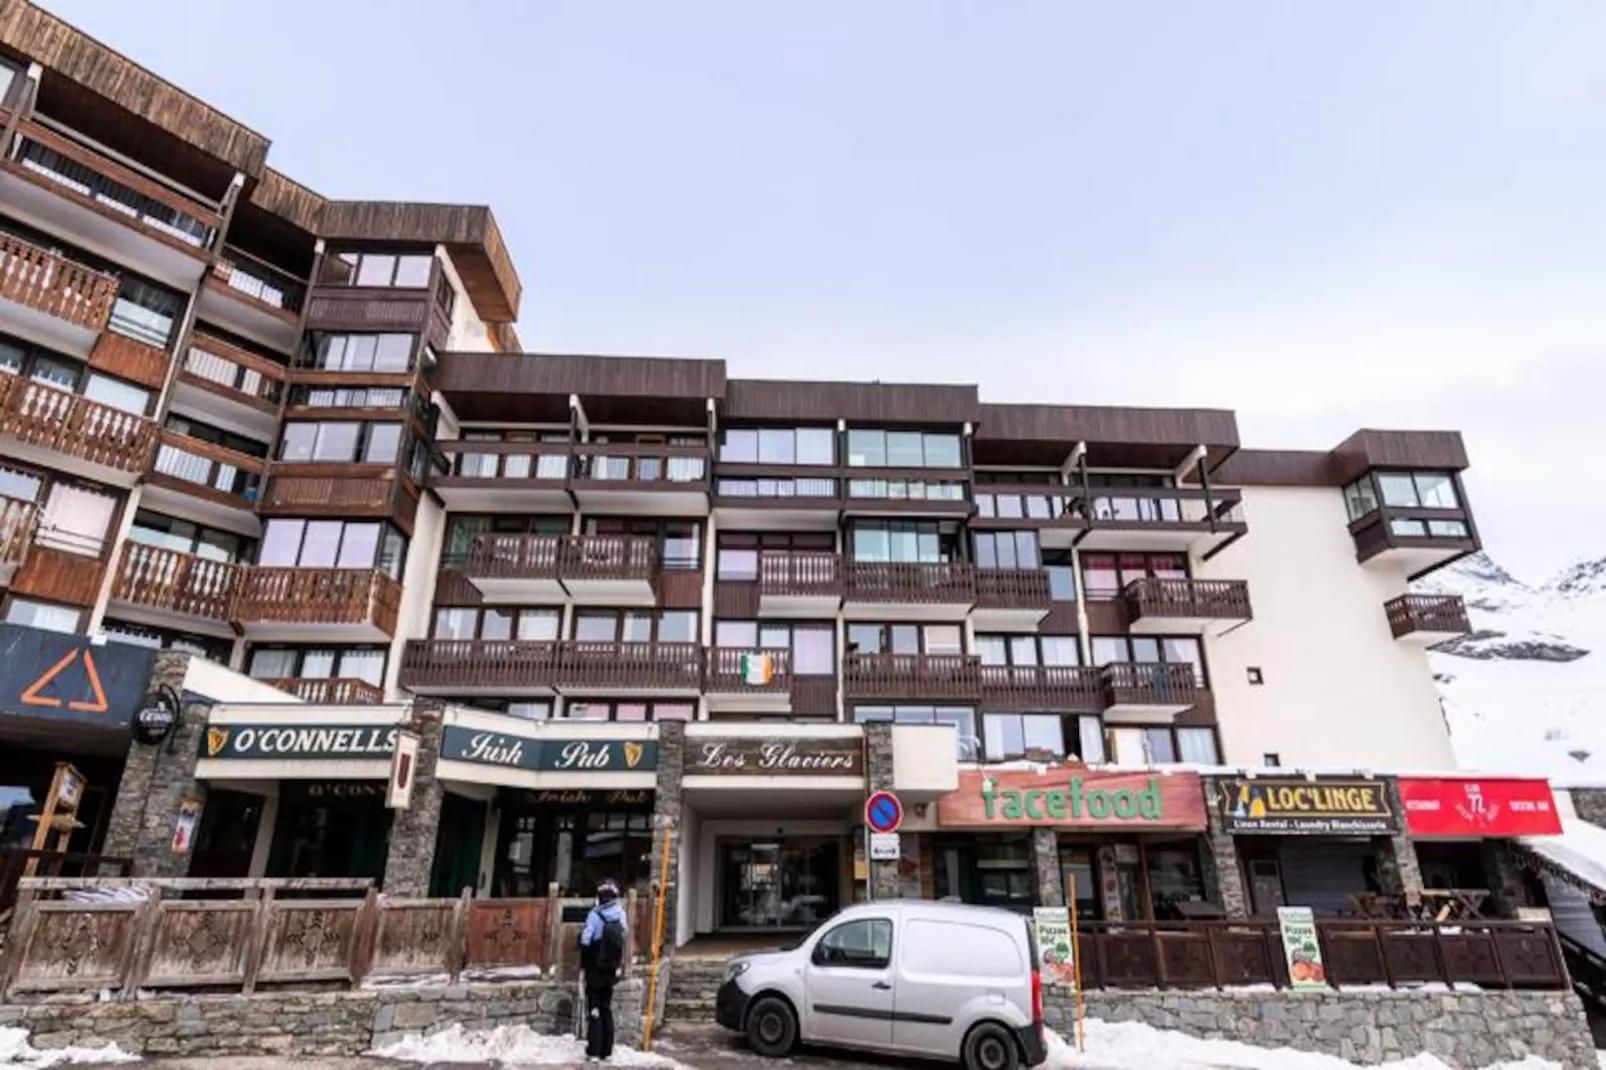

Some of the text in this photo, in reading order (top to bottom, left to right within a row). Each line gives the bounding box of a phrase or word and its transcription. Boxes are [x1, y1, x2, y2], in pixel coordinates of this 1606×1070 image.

[234, 727, 397, 754] O'CONNELLS
[461, 732, 610, 769] Irish Pub
[759, 743, 853, 768] Glaciers
[1266, 787, 1377, 811] LOC'LINGE
